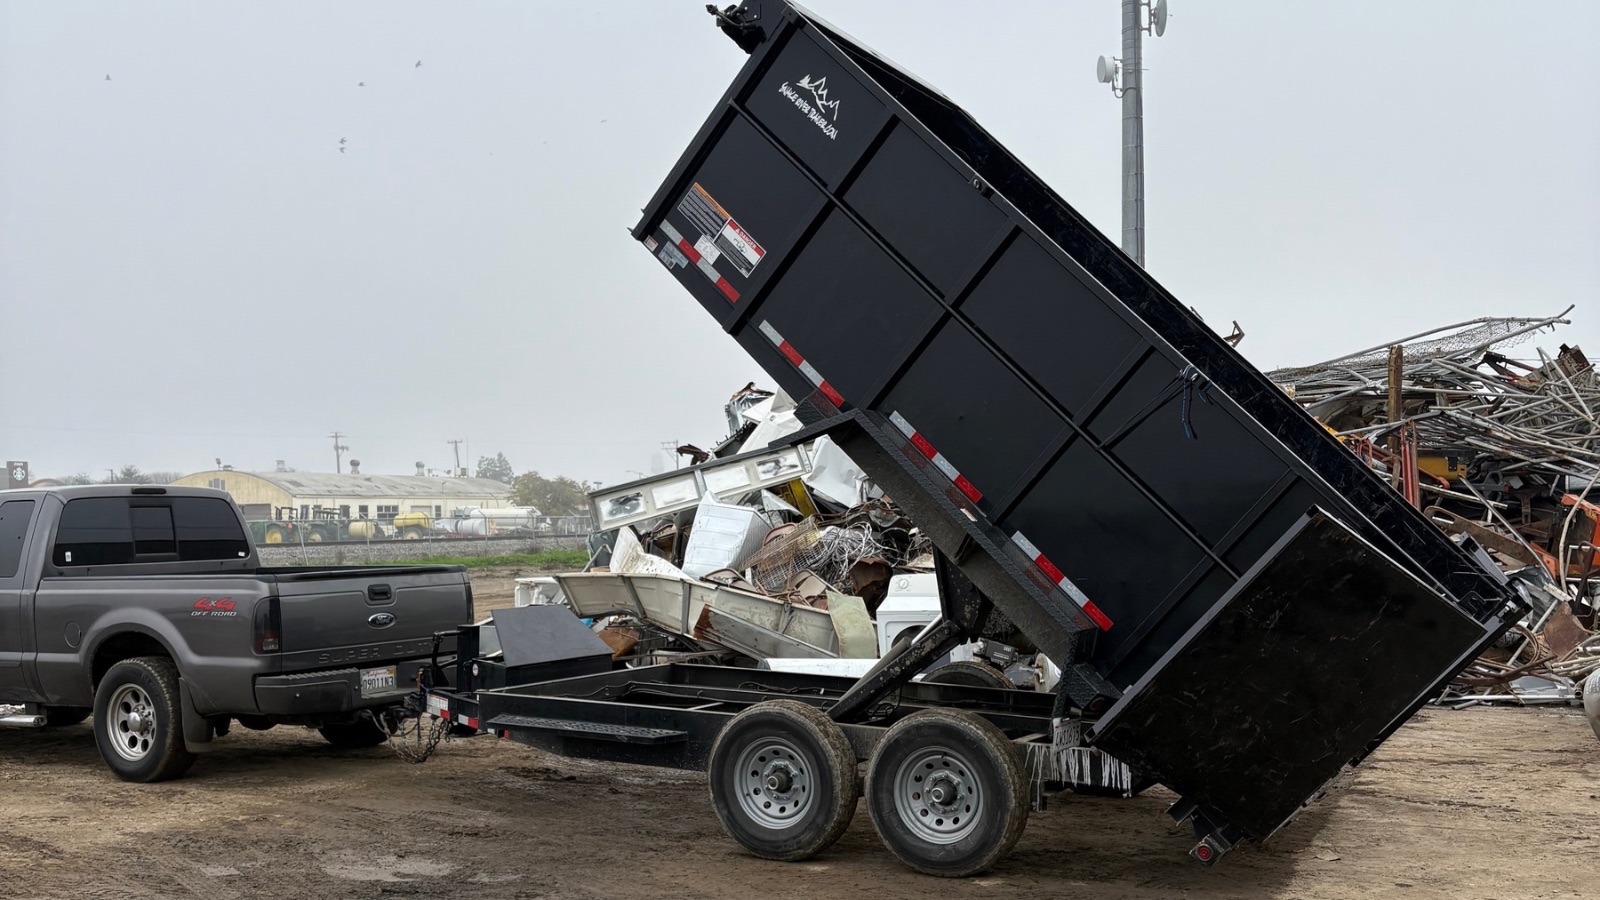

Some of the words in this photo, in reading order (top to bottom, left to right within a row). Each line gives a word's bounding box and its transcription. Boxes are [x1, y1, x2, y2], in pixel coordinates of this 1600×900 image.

[795, 97, 811, 114] RIVER
[738, 230, 758, 251] DANGER
[318, 647, 381, 664] SUPER
